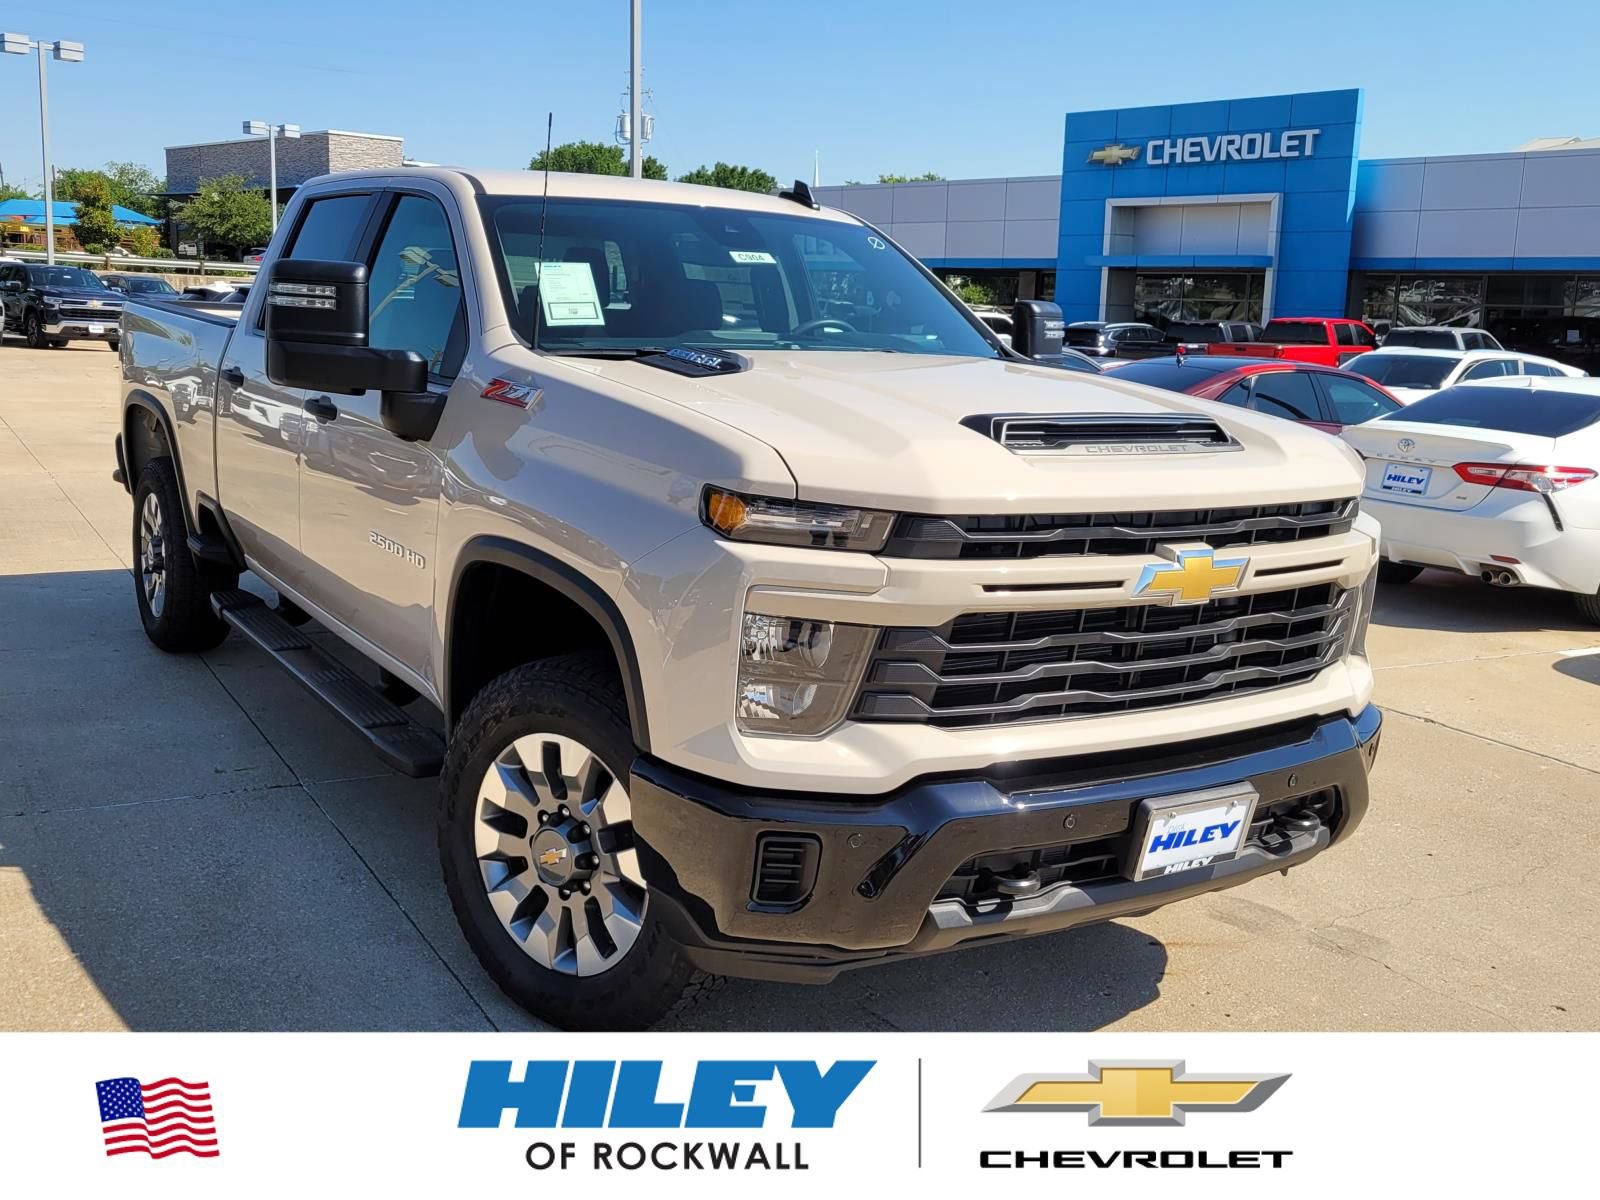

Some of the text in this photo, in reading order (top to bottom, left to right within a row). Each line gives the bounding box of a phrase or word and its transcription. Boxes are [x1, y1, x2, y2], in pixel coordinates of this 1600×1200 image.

[1146, 128, 1322, 165] CHEVROLET
[480, 377, 544, 410] Z71
[1084, 444, 1188, 454] CHEVROLET
[1386, 473, 1426, 485] HILEY
[369, 530, 426, 569] 2500 HD
[1148, 819, 1241, 854] HILEY
[1163, 855, 1215, 875] HILEY
